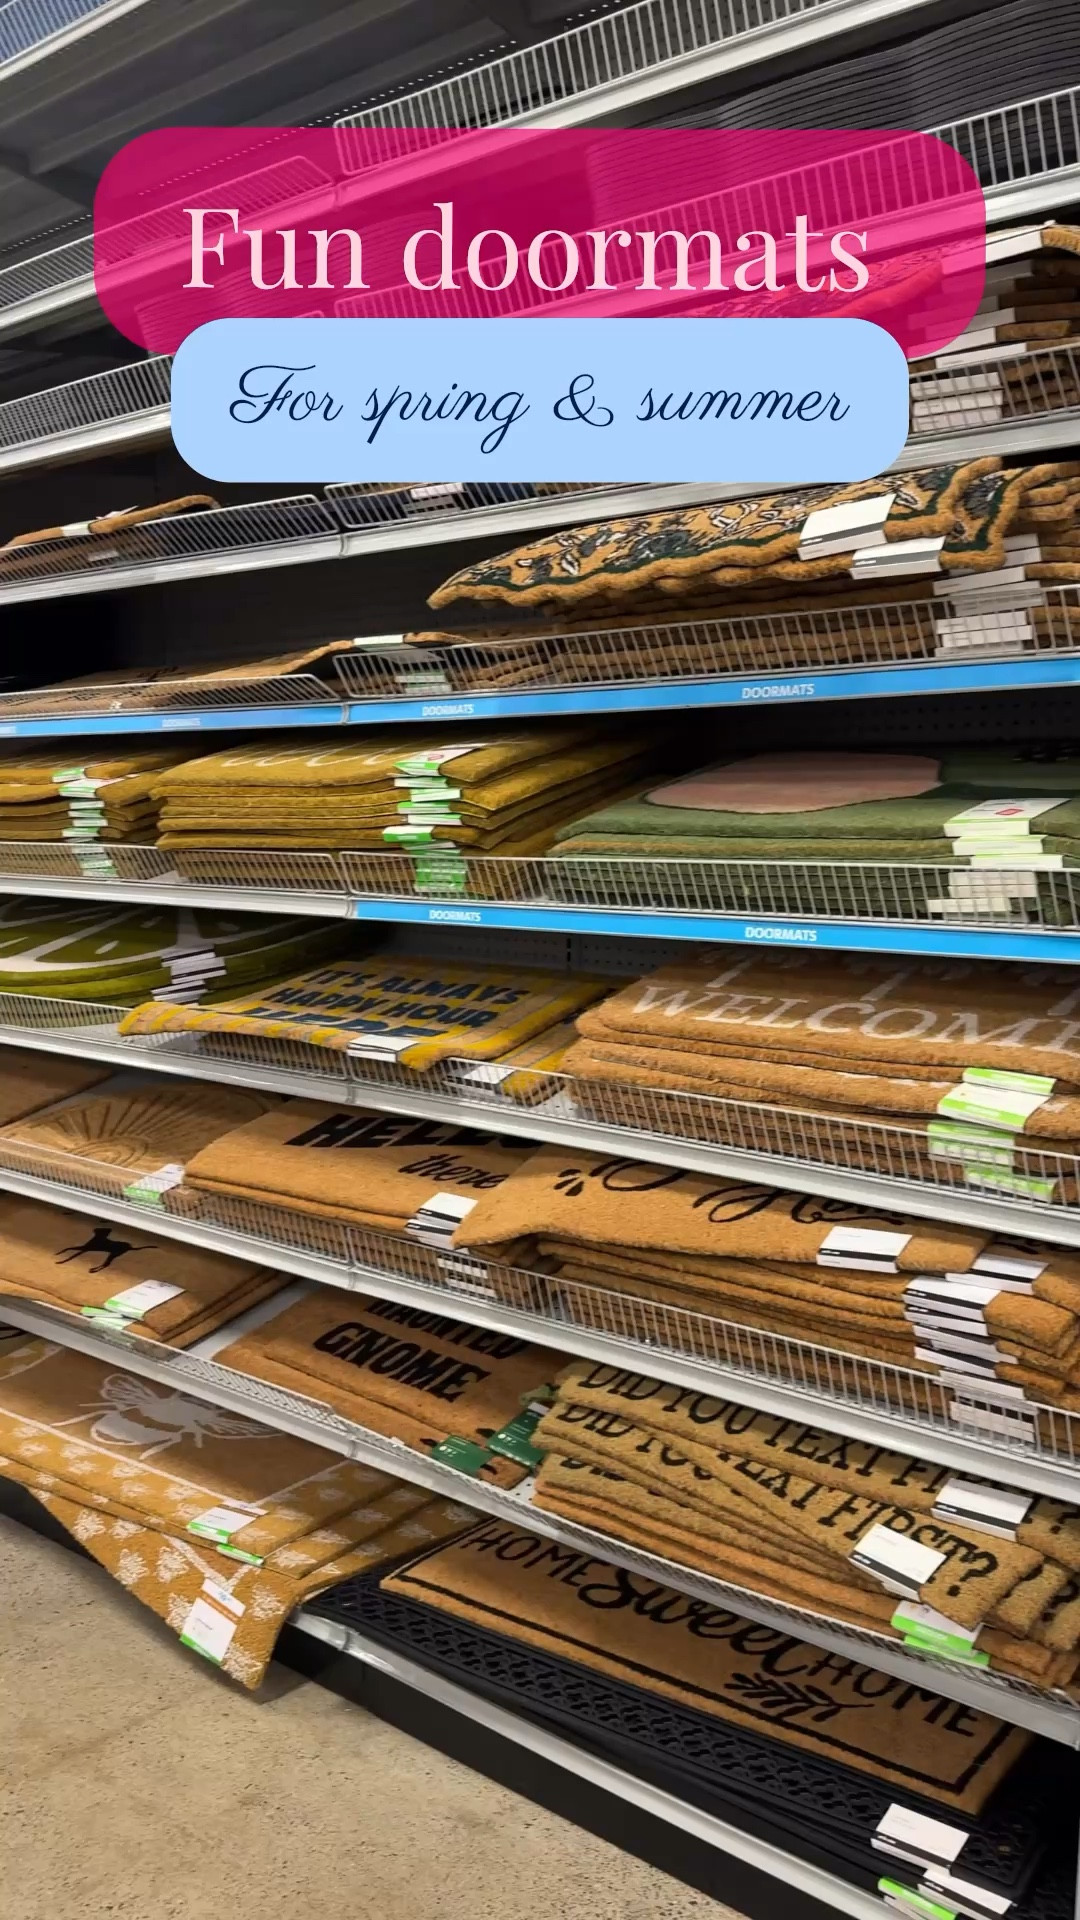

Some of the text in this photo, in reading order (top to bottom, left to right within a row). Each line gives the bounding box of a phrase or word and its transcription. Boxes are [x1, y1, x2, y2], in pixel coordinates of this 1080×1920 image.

[742, 683, 815, 699] DOORMATS
[744, 926, 817, 941] DOORMATS
[301, 969, 531, 1005] IT'S ALWAYS
[262, 987, 390, 1013] HAPPY
[380, 1001, 500, 1029] HOUR
[397, 1153, 510, 1189] there
[312, 1321, 493, 1403] GNOME
[460, 1527, 611, 1588] HOME
[807, 1650, 978, 1738] HOME
